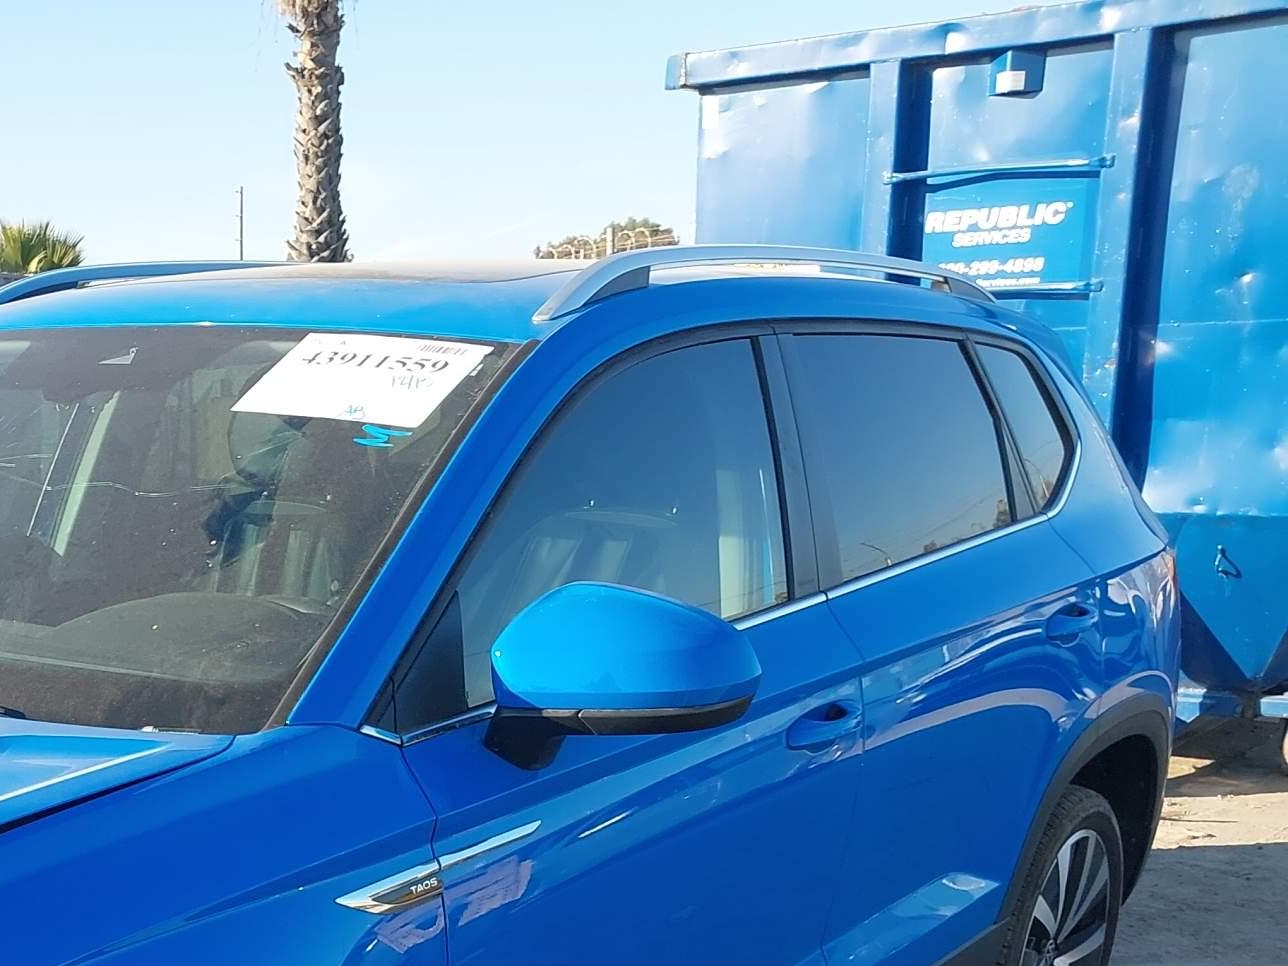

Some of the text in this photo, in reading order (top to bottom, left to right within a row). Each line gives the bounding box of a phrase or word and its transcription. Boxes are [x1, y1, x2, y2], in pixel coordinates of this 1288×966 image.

[925, 202, 1067, 233] REPUBLIC
[952, 228, 1031, 247] SERVICES
[302, 350, 449, 373] 43911559
[410, 877, 439, 895] TAOS
